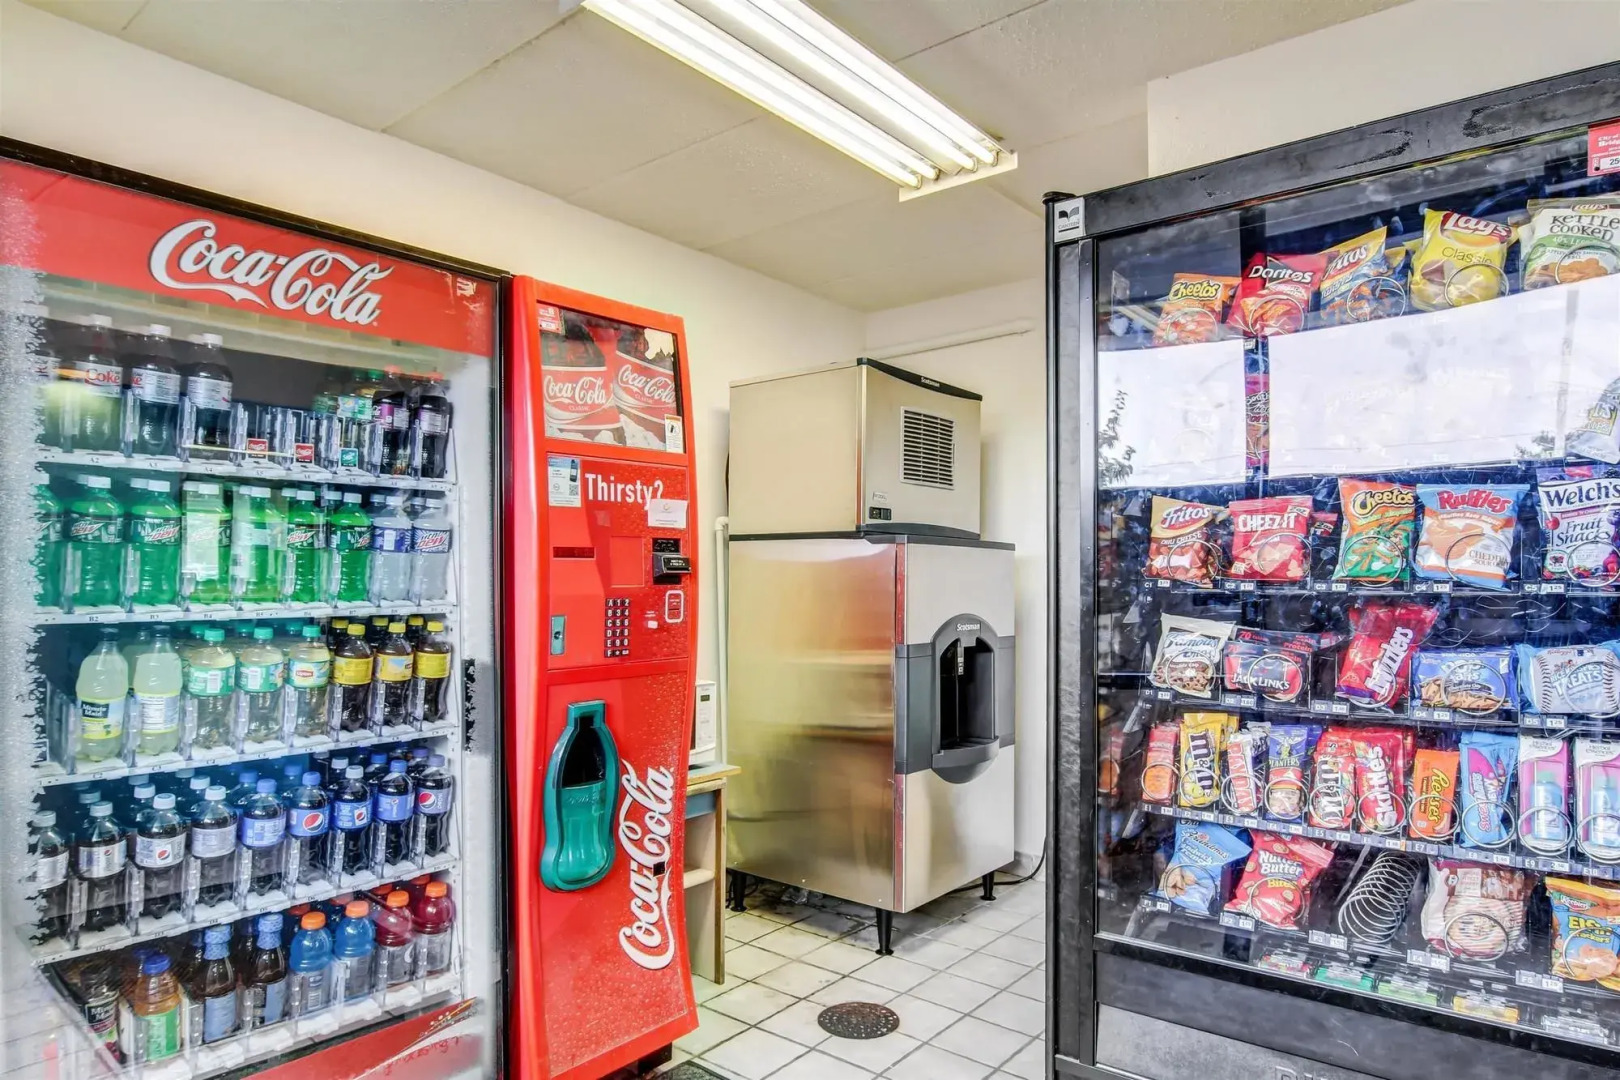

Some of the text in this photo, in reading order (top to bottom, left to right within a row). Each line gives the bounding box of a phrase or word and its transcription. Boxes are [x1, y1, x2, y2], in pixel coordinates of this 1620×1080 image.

[1057, 221, 1080, 230] CANTEEN
[1445, 211, 1511, 237] Lay's
[149, 219, 395, 327] Coca-Cola
[1249, 265, 1313, 283] Doritos
[1169, 280, 1220, 300] Cheetos
[84, 366, 120, 385] Coke
[618, 364, 676, 404] Coca-Cola
[543, 375, 608, 405] Coca-Cola
[584, 472, 664, 510] Thirsty?
[1542, 482, 1620, 507] Welch's
[1353, 489, 1415, 515] Cheetos
[1437, 488, 1514, 514] Ruffles
[1161, 504, 1212, 529] Fritos
[1566, 518, 1603, 534] Fruit
[1557, 529, 1611, 547] Snacks
[956, 622, 981, 632] Scotsman
[1165, 632, 1219, 648] Famous
[1231, 673, 1258, 686] JACK
[1268, 758, 1300, 768] PLANTERS
[1428, 767, 1450, 824] Reese's
[1415, 844, 1424, 852] E7
[618, 758, 675, 970] Coca-Cola
[1260, 862, 1304, 877] Butter
[1525, 859, 1536, 867] E9
[1267, 878, 1297, 890] Bites
